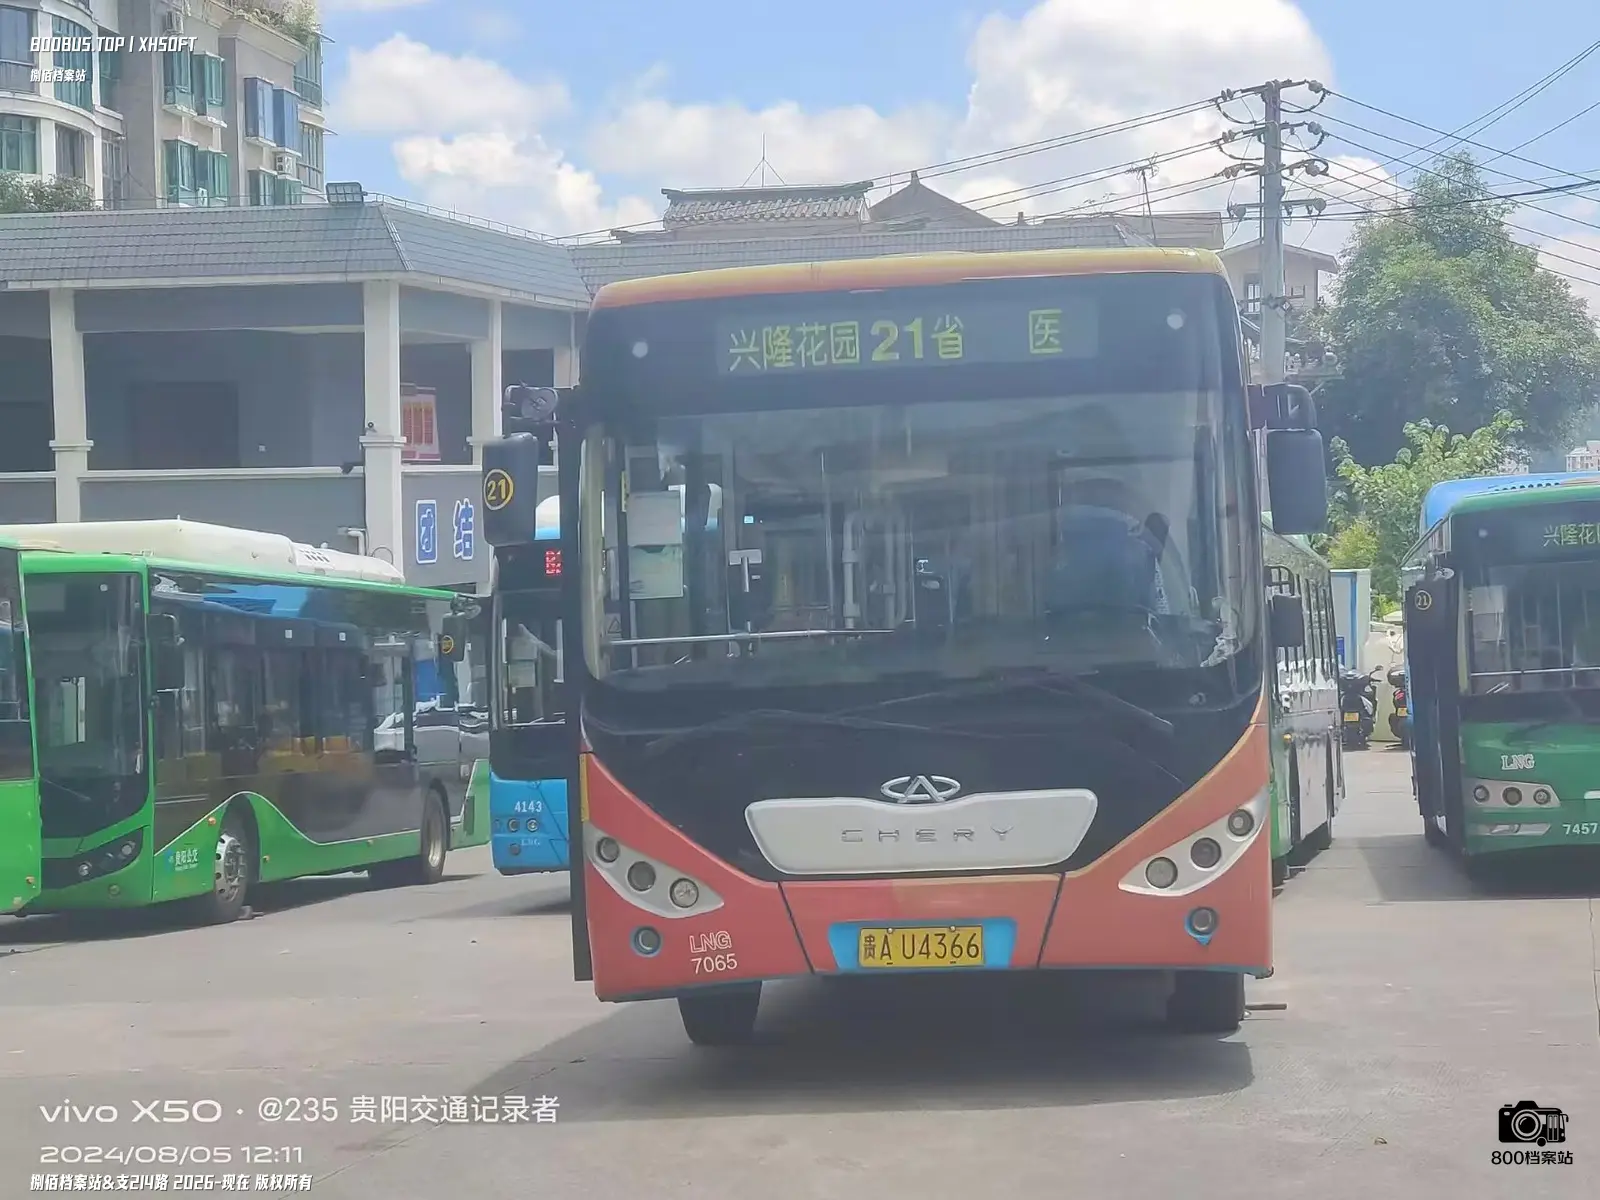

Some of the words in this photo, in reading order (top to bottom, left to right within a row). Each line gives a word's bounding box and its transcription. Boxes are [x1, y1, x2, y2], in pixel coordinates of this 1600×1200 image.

[728, 320, 860, 371] 兴隆花园
[870, 317, 923, 361] 21
[486, 478, 507, 501] 21
[1543, 522, 1600, 547] 兴隆花
[1416, 594, 1429, 606] 21
[1501, 753, 1535, 771] LNG
[514, 800, 543, 813] 4143
[841, 824, 1015, 843] CHERY
[1562, 822, 1599, 835] 7457
[689, 930, 733, 953] LNG
[690, 953, 738, 974] 7065
